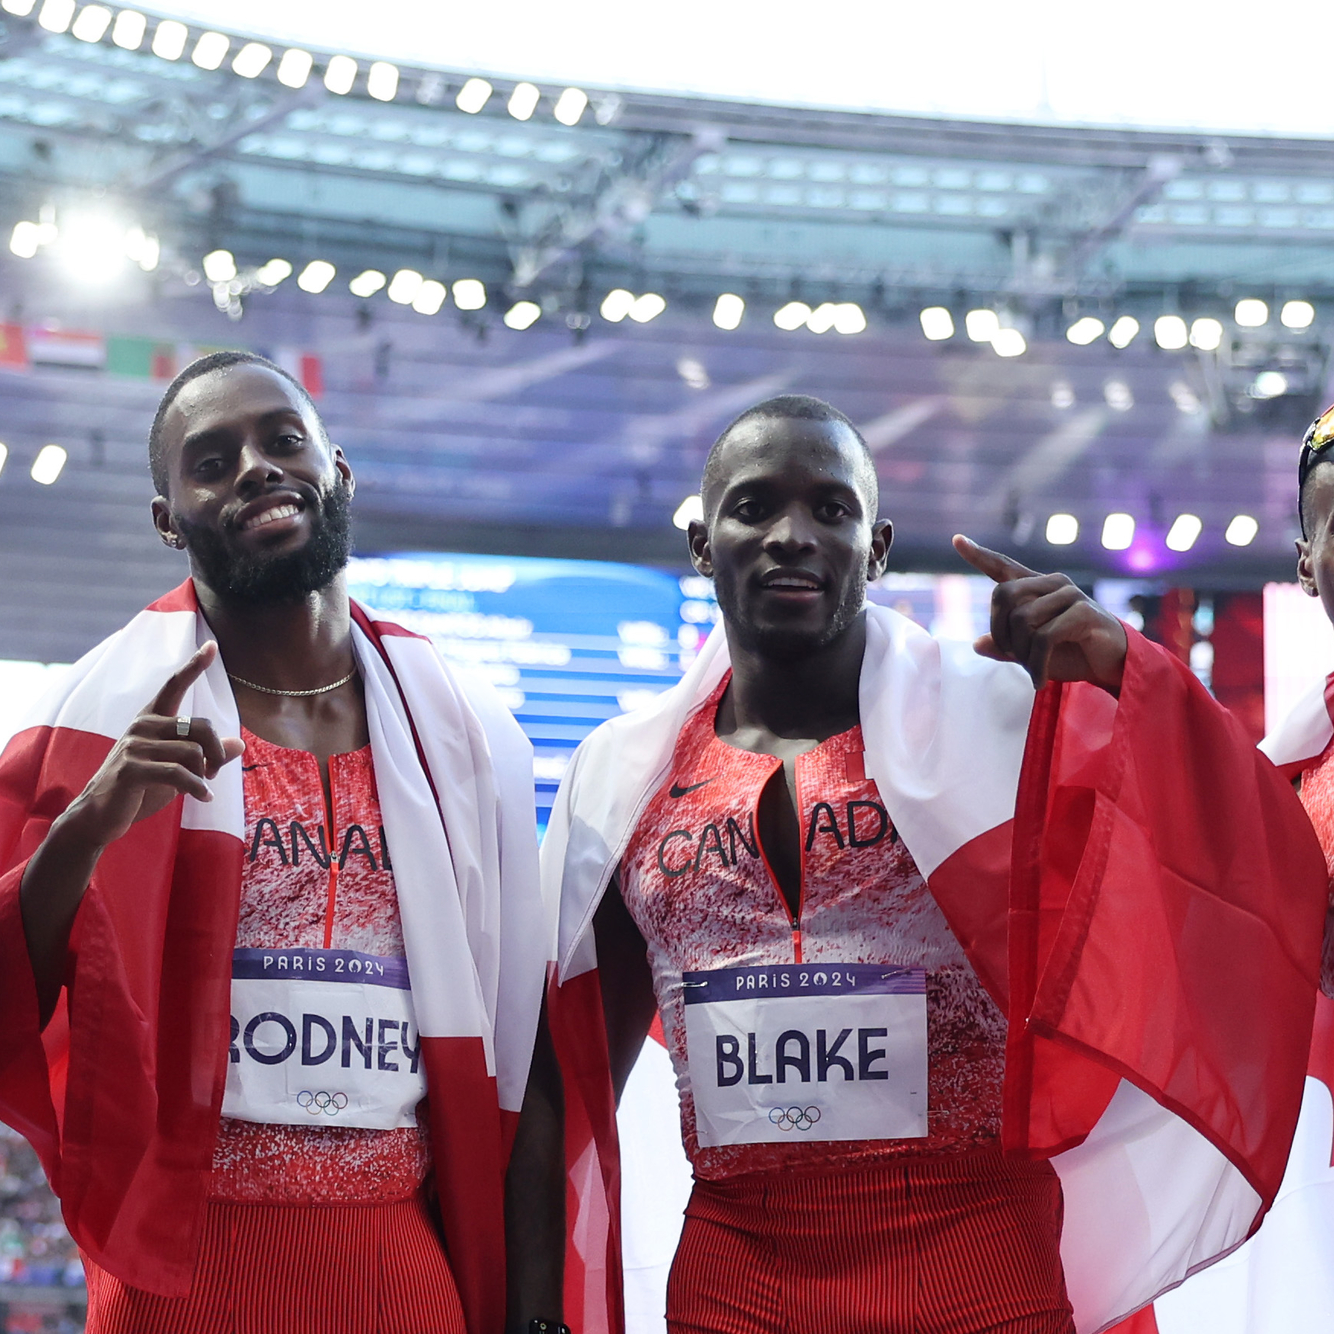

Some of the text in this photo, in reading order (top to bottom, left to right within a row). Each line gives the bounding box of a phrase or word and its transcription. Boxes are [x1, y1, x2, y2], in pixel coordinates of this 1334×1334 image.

[246, 817, 392, 871] ANA
[658, 800, 898, 878] CANAD
[334, 957, 385, 976] 2024
[799, 971, 856, 987] 2024
[716, 1027, 889, 1087] BLAKE
